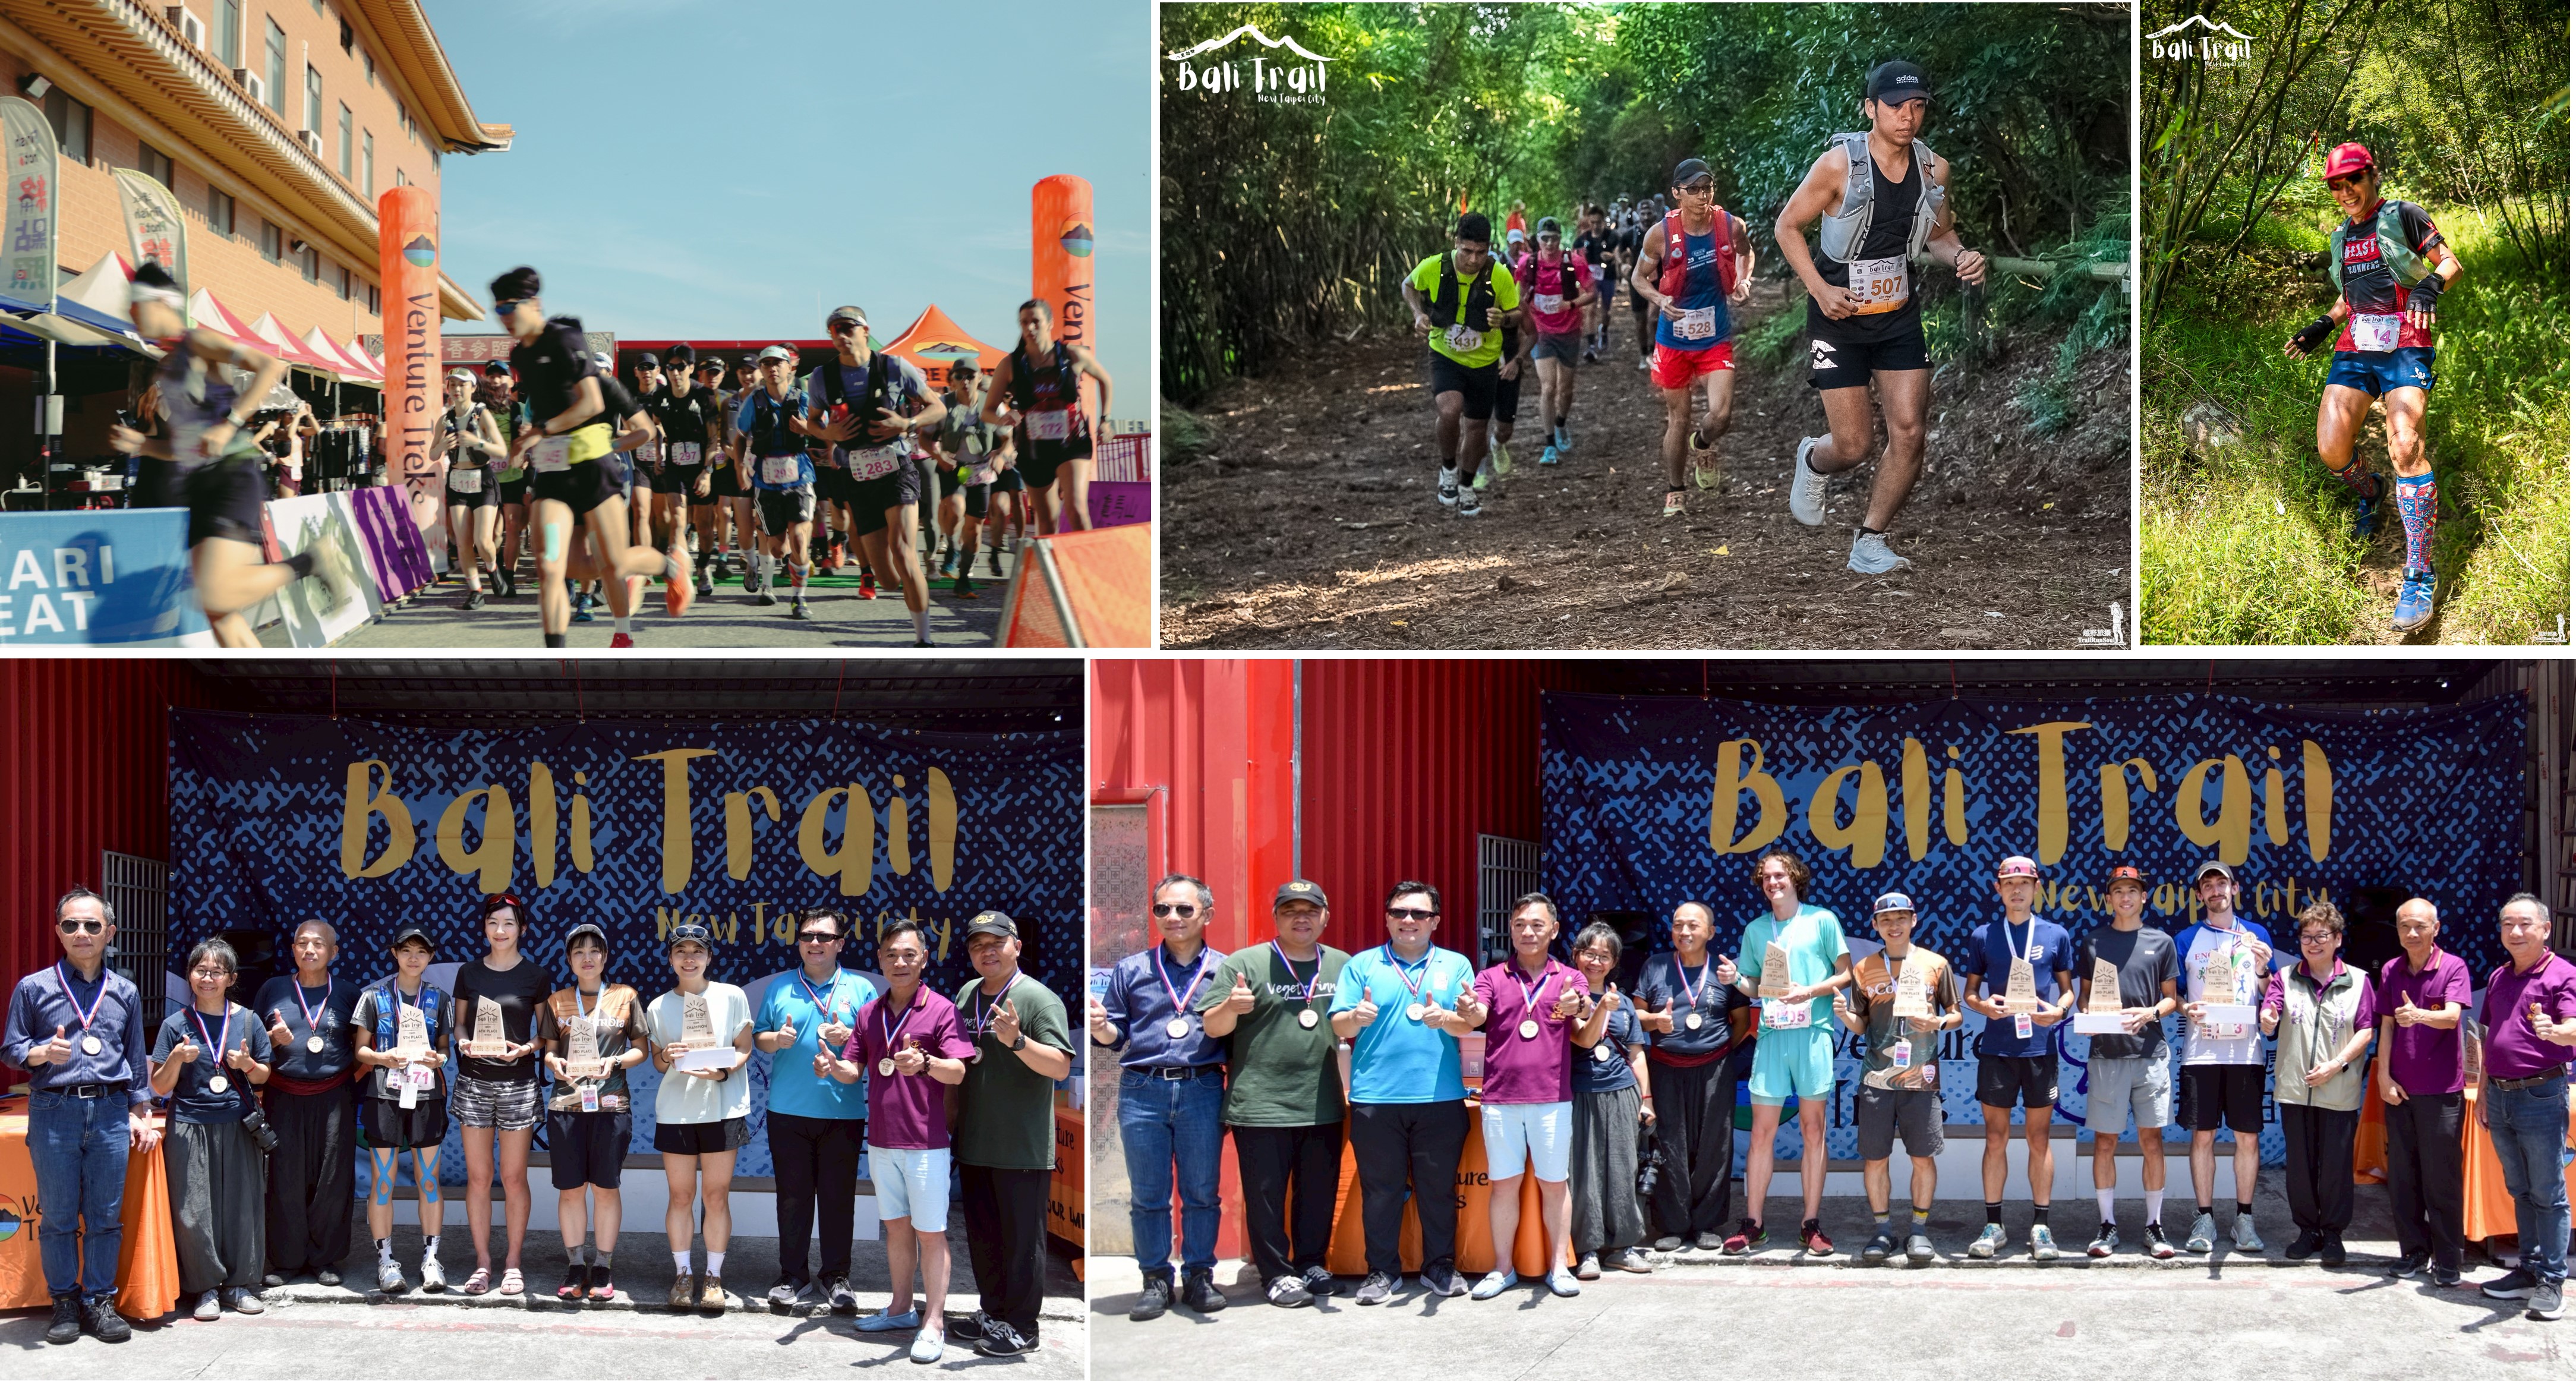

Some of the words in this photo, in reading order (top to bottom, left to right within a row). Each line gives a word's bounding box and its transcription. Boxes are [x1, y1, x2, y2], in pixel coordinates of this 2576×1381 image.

[1844, 204, 1864, 217] SALOMON
[2344, 237, 2376, 258] BEAST
[2347, 260, 2380, 275] RUNNERS
[1871, 275, 1902, 296] 507
[1688, 321, 1711, 335] 528
[1457, 337, 1477, 347] 431
[404, 292, 434, 414] Venture
[679, 451, 696, 461] 297
[865, 459, 893, 475] 283
[459, 480, 477, 489] 116
[1710, 737, 1969, 869] Bali
[2004, 721, 2334, 868] Trail
[340, 759, 594, 894] Bali
[630, 748, 957, 896] Trail
